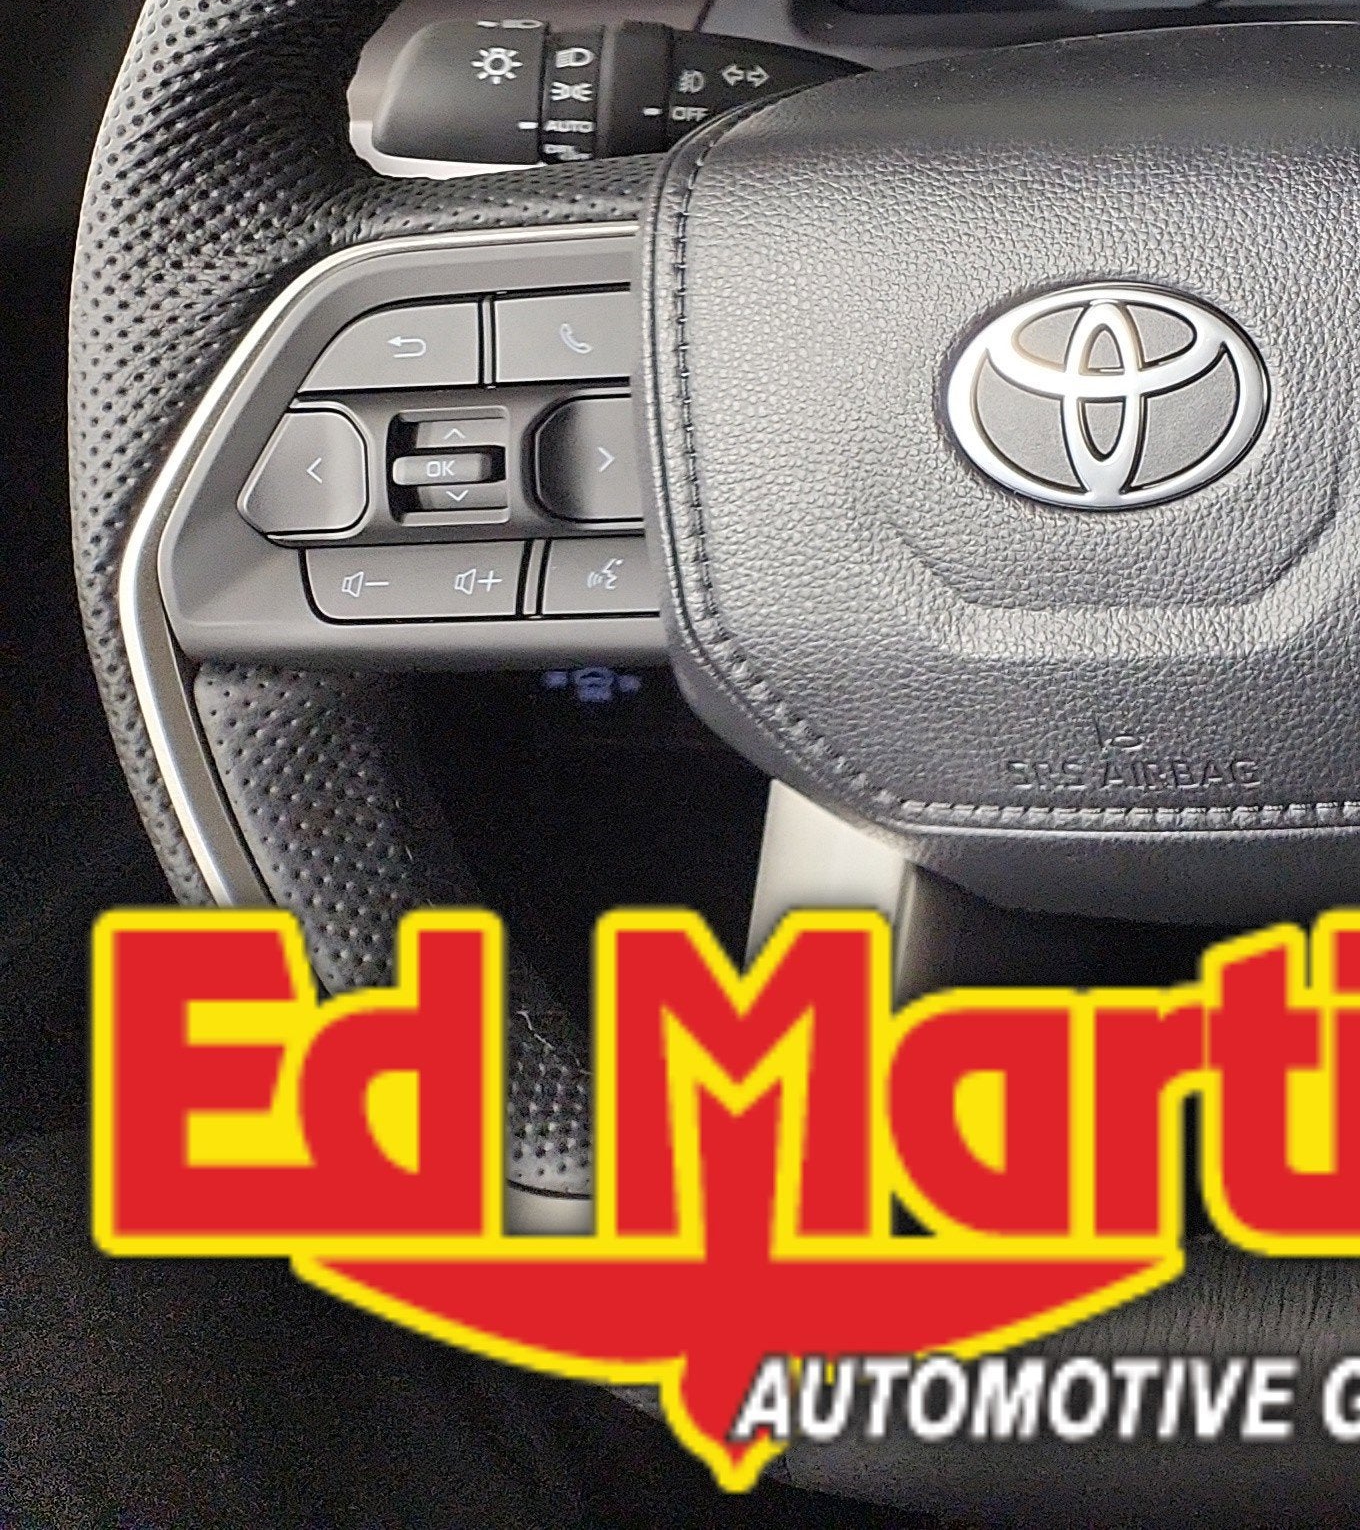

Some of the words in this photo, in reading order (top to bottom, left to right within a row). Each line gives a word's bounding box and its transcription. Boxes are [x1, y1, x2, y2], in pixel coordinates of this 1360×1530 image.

[671, 106, 709, 122] OFF
[543, 120, 595, 133] AUTO
[426, 460, 455, 478] OK
[1103, 759, 1261, 790] AIRBAG
